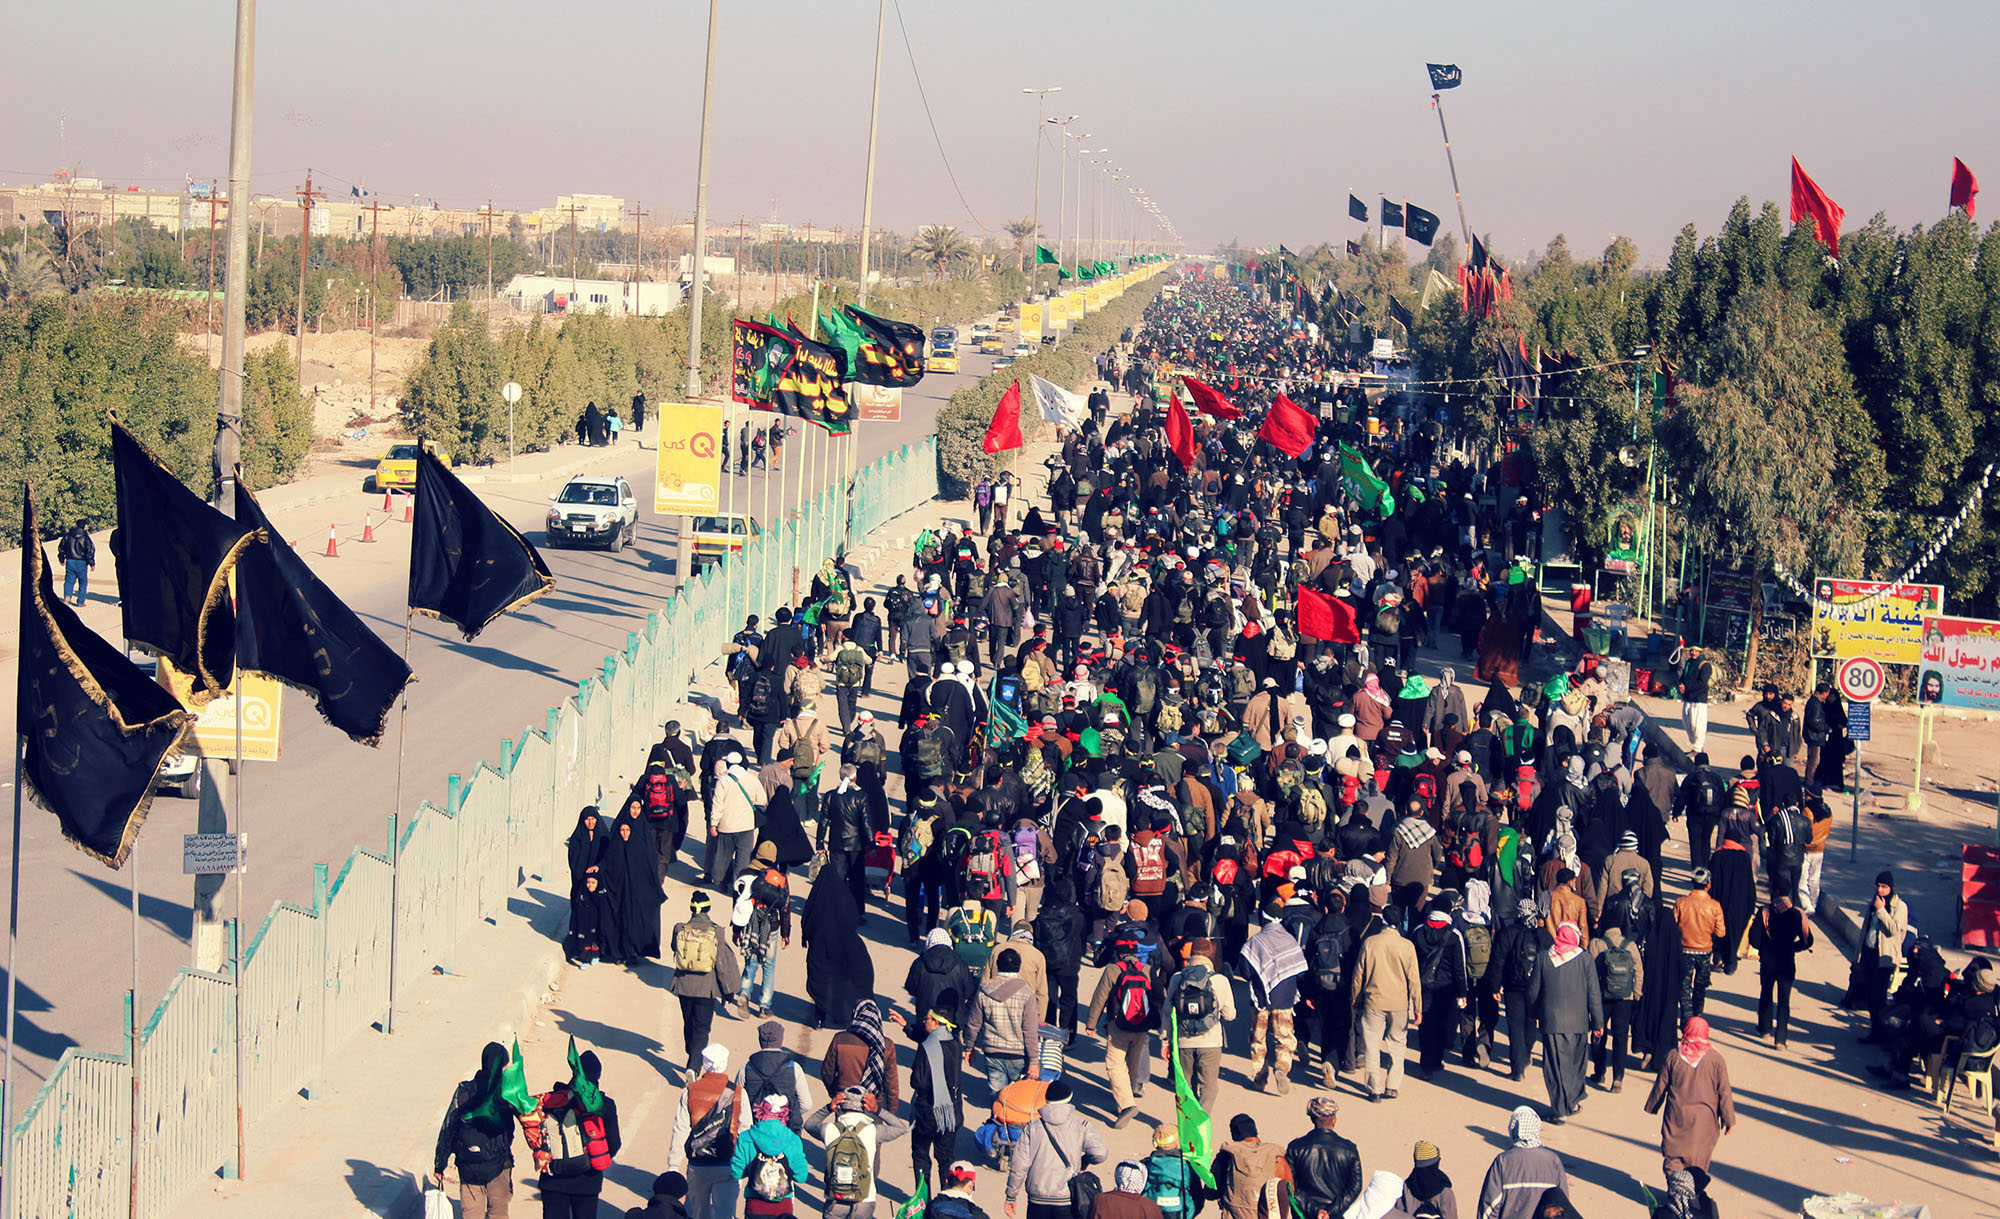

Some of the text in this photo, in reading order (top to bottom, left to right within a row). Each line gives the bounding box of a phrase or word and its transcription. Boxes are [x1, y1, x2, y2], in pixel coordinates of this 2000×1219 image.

[664, 432, 715, 458] كي Q
[1881, 604, 1923, 631] فينة
[1966, 625, 2000, 640] وكب
[1924, 646, 1945, 662] الله
[1948, 648, 1986, 670] رسول
[1849, 668, 1875, 689] 80
[243, 700, 267, 727] Q
